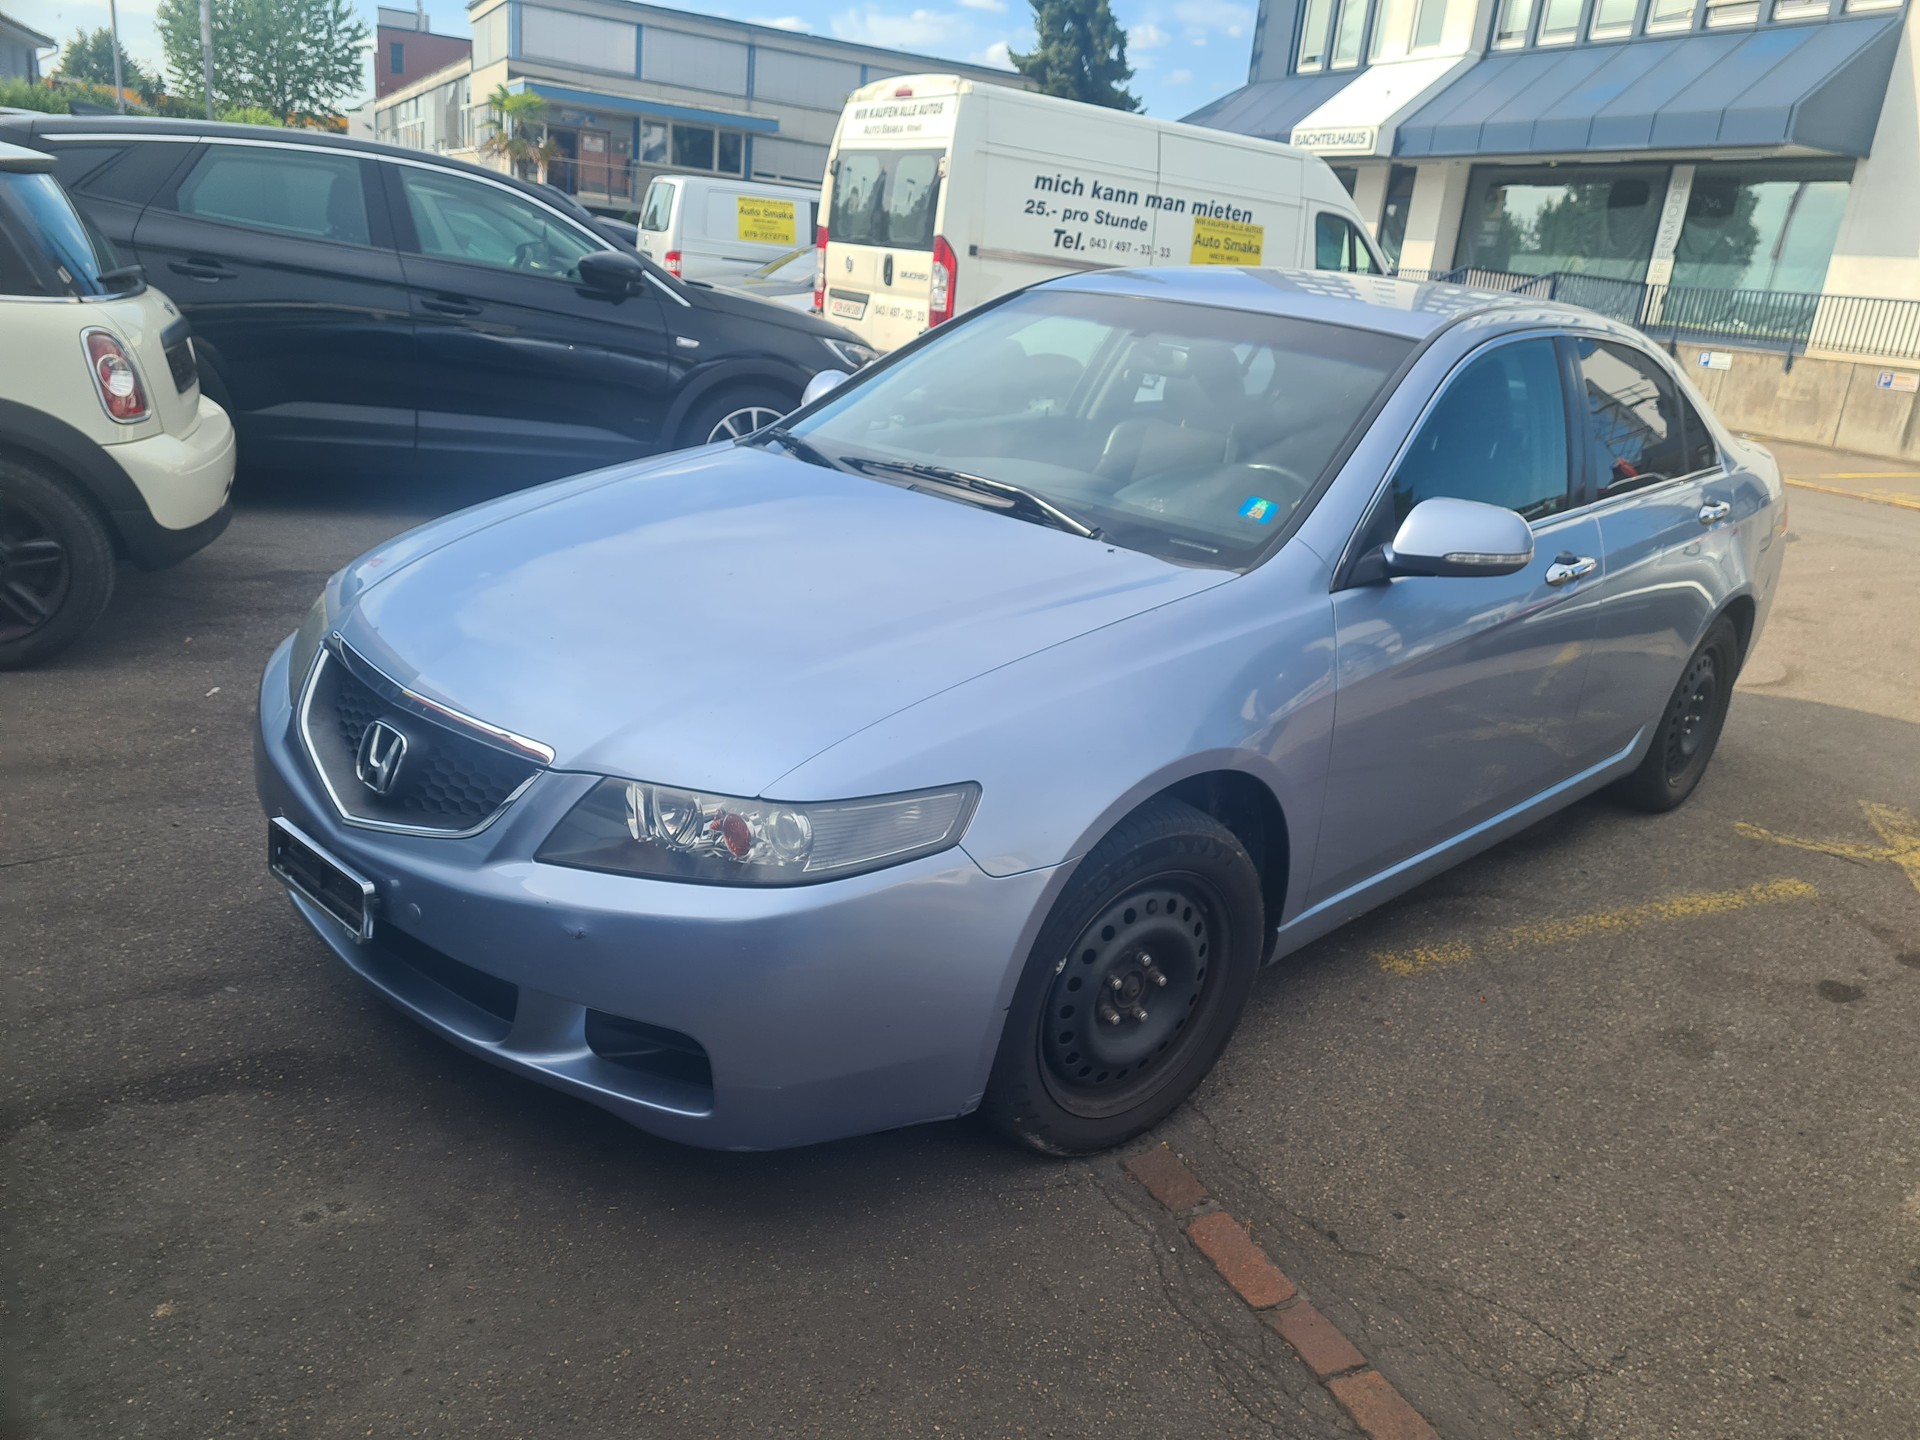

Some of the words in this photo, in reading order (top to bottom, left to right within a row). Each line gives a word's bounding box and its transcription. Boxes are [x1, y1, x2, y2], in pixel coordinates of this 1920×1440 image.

[1294, 131, 1367, 145] BACHTELHAUS
[1034, 174, 1084, 197] mich
[1091, 180, 1138, 205] kann
[1145, 192, 1186, 213] man
[1191, 200, 1253, 223] mieten
[738, 206, 761, 217] Auto
[1024, 199, 1058, 217] 25.-
[1061, 207, 1089, 222] pro
[1094, 209, 1148, 232] Stunde
[1053, 228, 1086, 251] Tel.
[1194, 233, 1221, 249] Auto
[1223, 237, 1261, 254] Smaka
